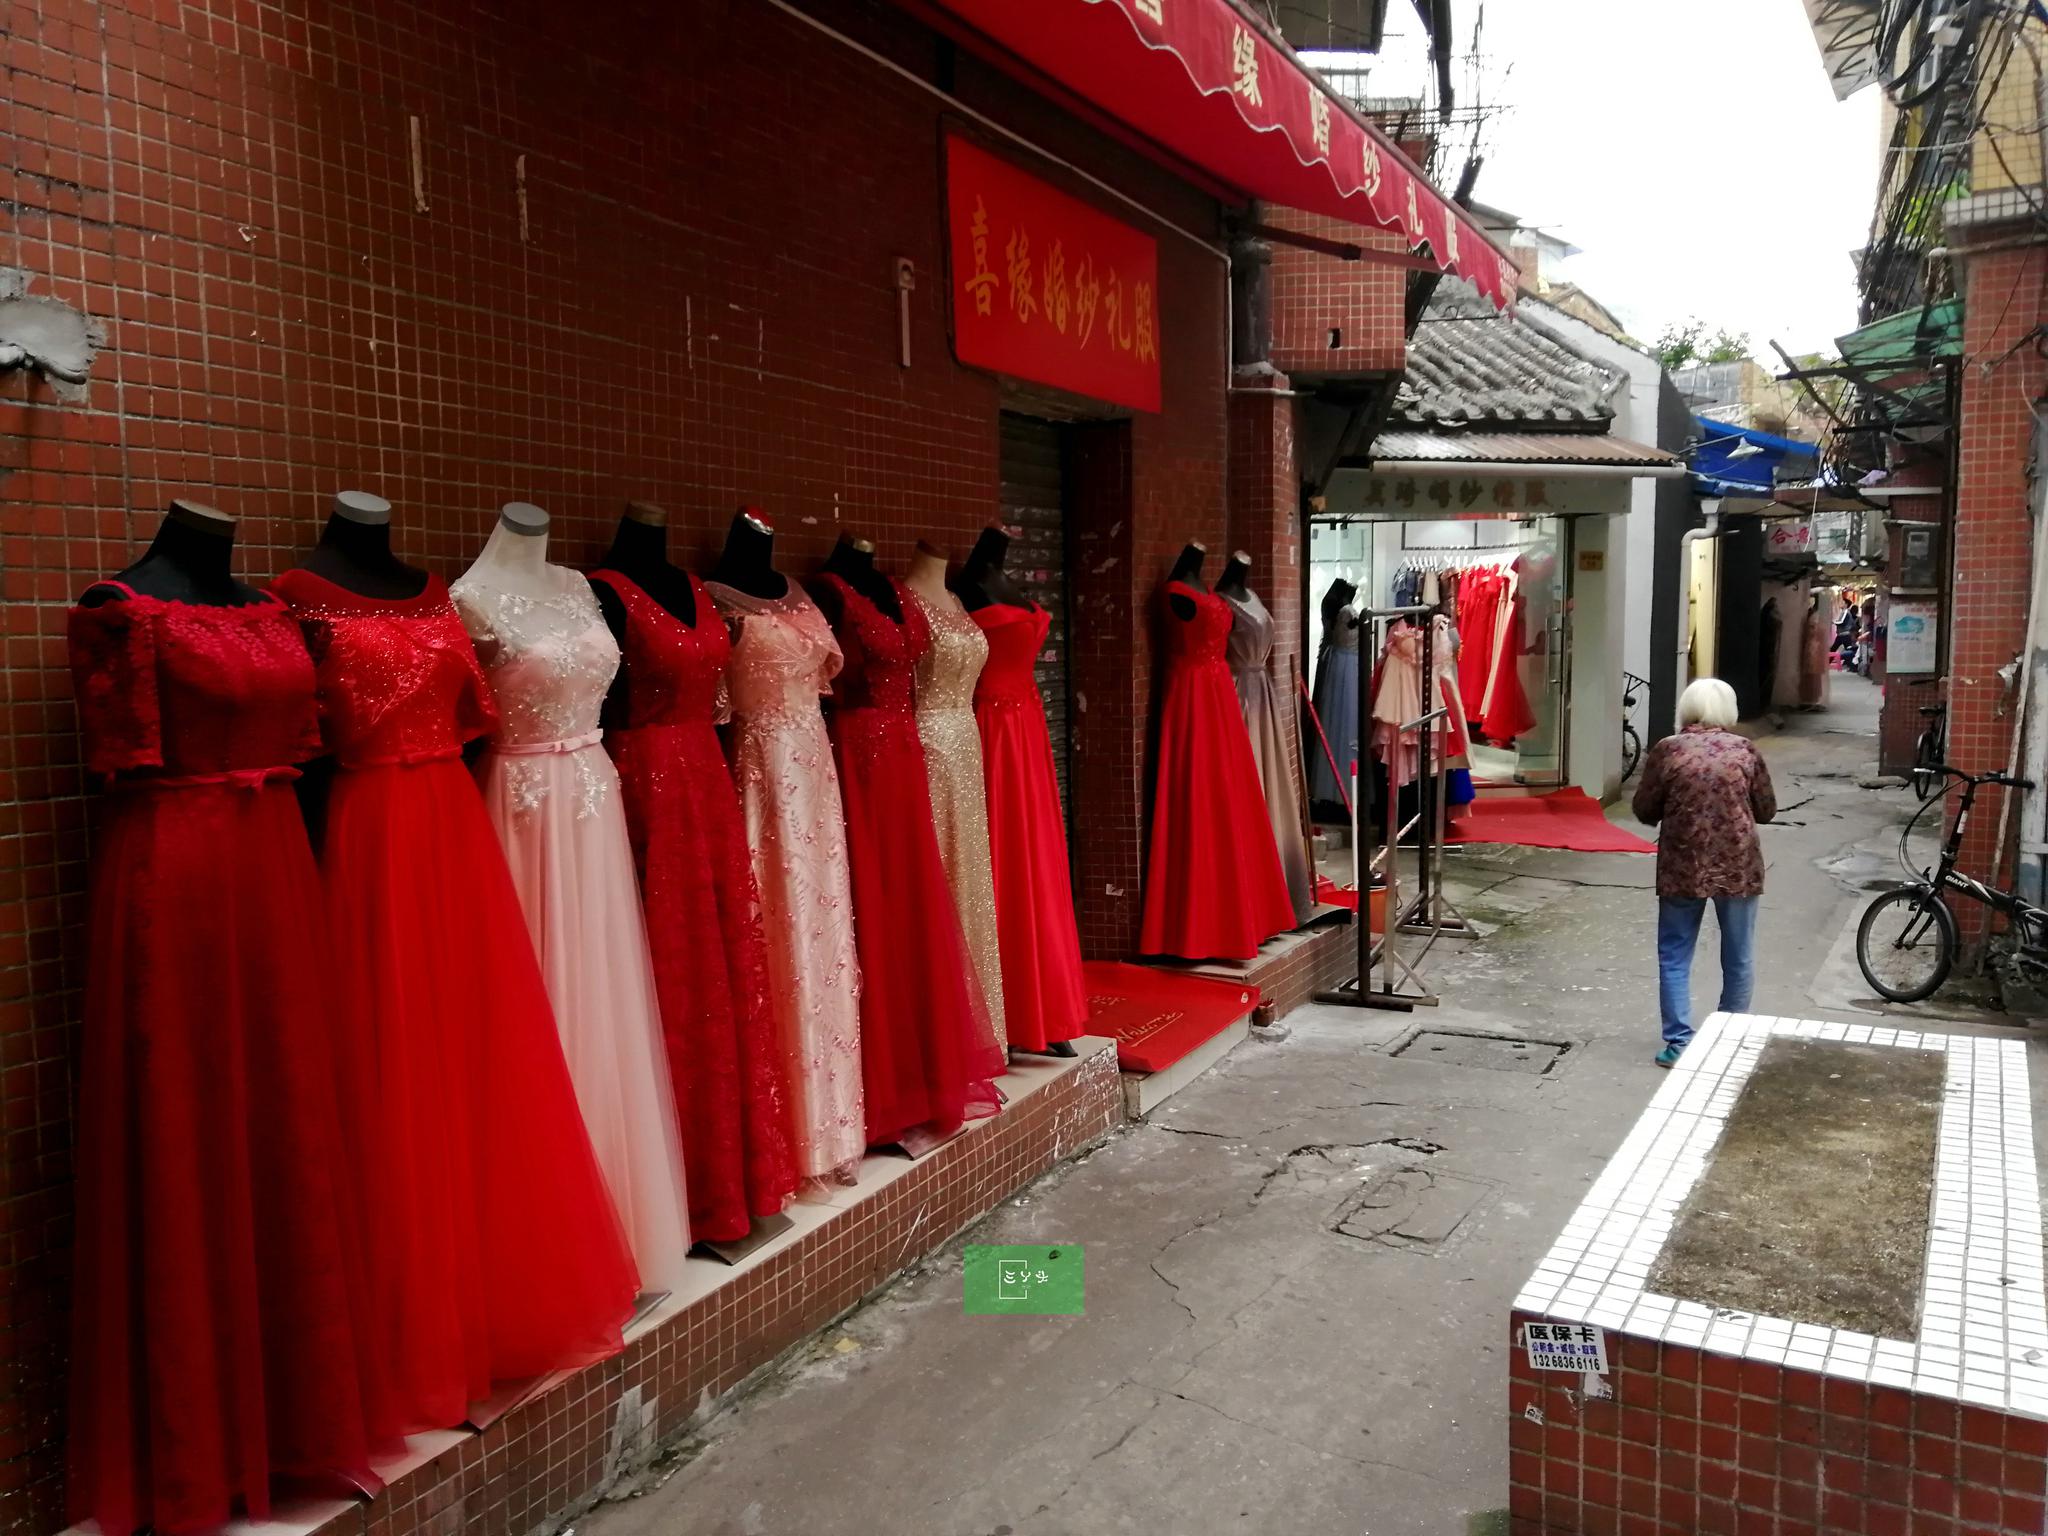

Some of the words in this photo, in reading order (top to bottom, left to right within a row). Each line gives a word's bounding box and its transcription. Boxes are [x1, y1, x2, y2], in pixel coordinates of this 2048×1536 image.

[964, 194, 1156, 363] 喜缘婚纱礼服
[1945, 875, 1969, 889] GIANT
[1529, 1325, 1596, 1343] 医保卡
[1533, 1354, 1551, 1368] 132
[1552, 1355, 1575, 1369] 6836
[1577, 1357, 1600, 1371] 6116
